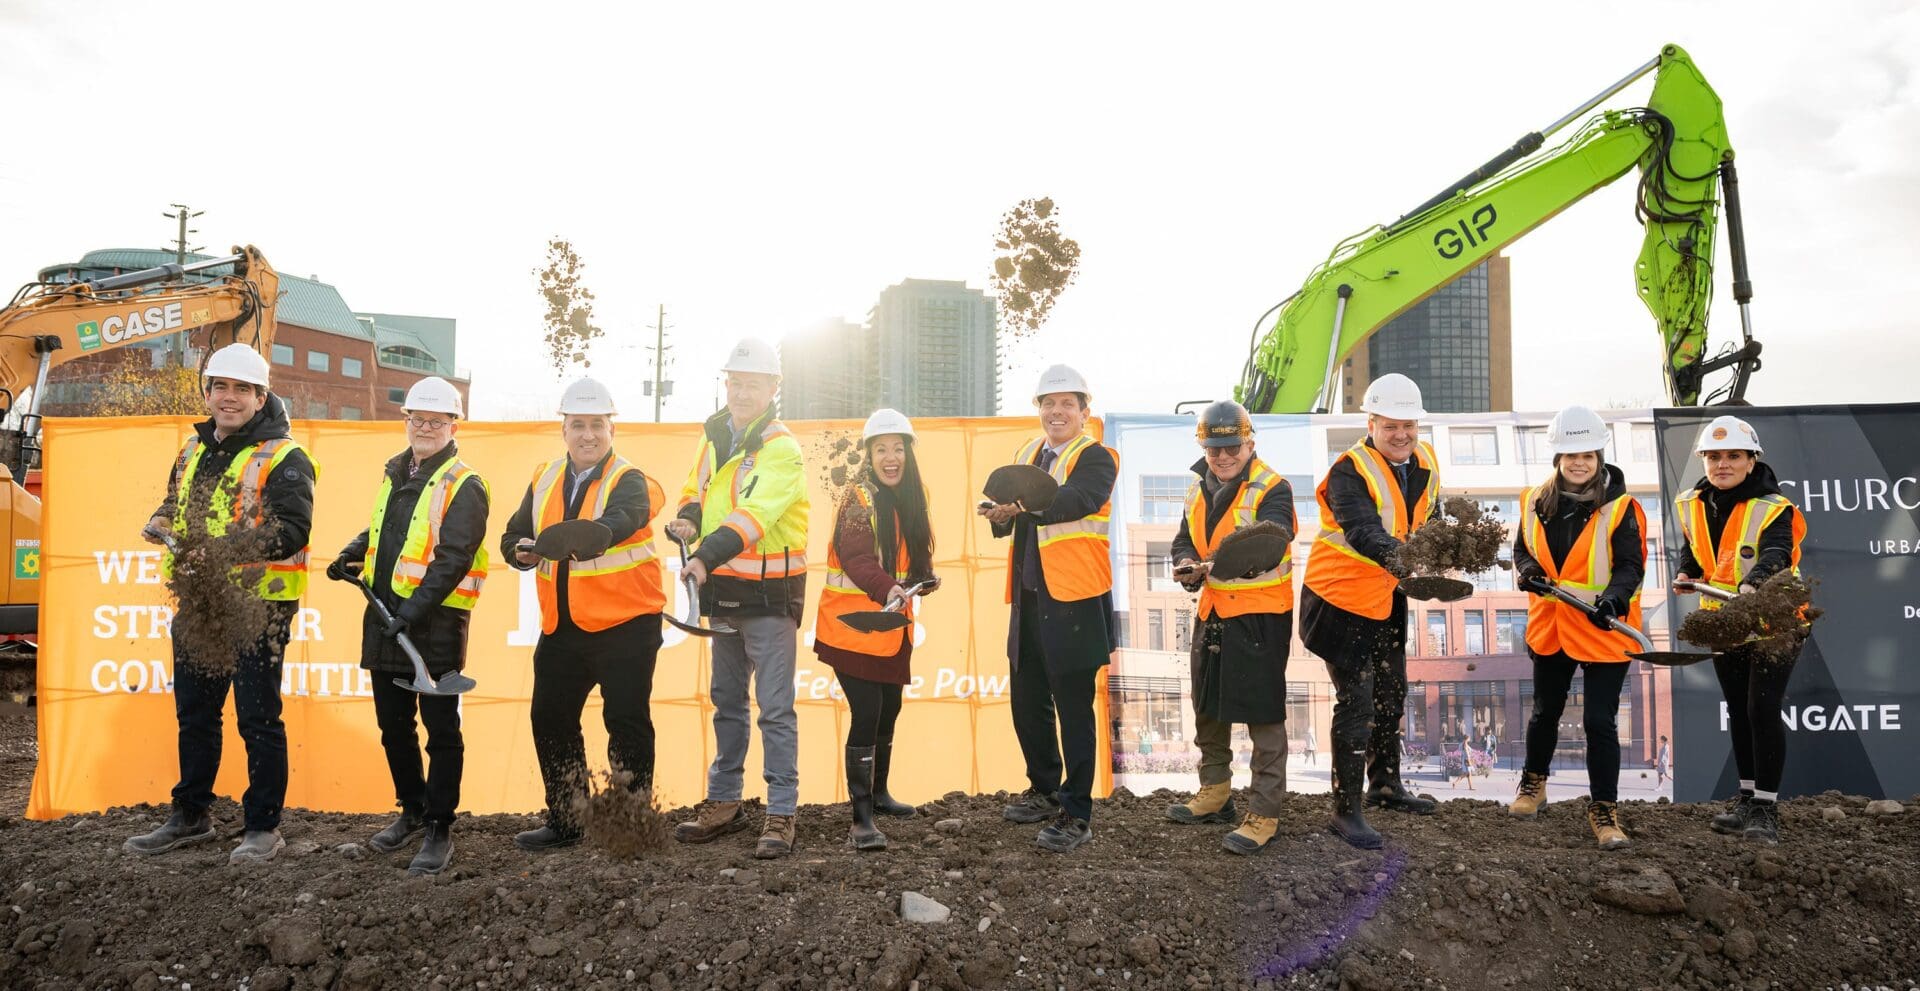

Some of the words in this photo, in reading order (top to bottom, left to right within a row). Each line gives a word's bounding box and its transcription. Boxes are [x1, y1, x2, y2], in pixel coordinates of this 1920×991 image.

[1433, 203, 1498, 260] GIP
[101, 302, 183, 344] CASE
[93, 550, 161, 584] WE
[92, 604, 324, 641] STRR
[793, 669, 847, 700] Fee
[933, 667, 1010, 699] Pow
[1719, 700, 1901, 732] FNGATE
